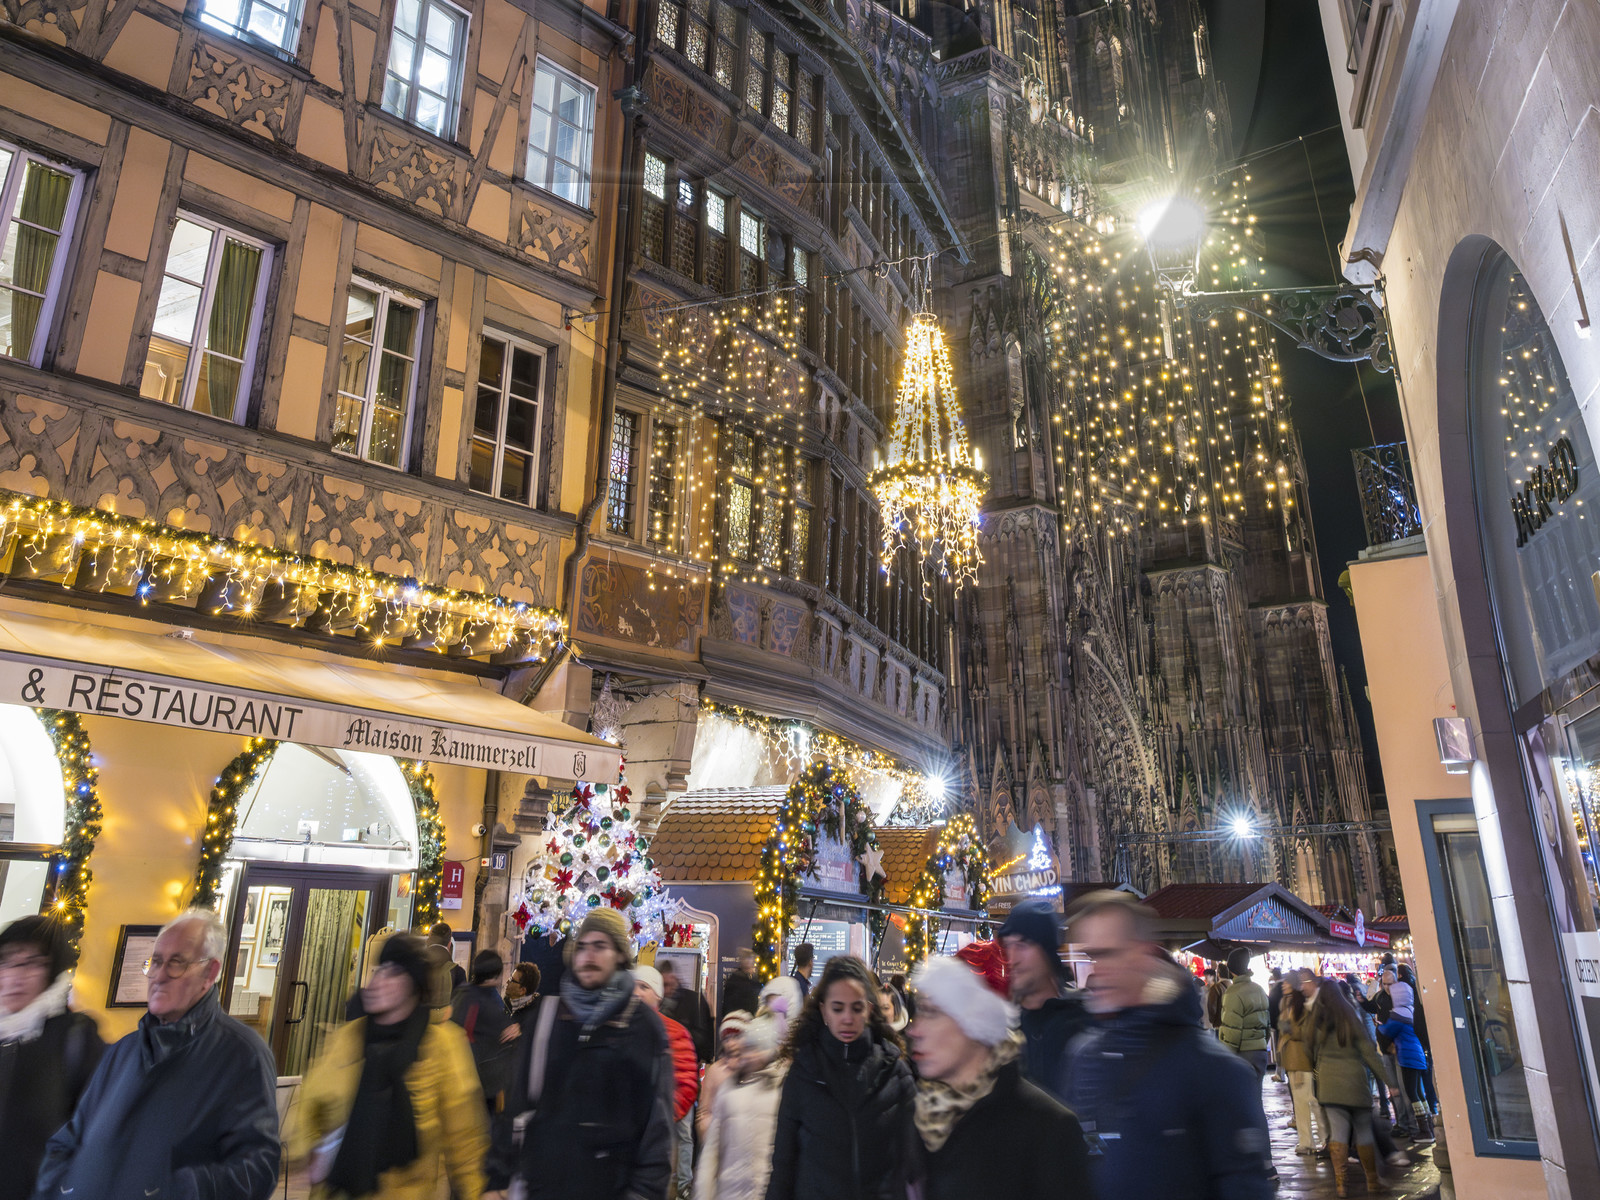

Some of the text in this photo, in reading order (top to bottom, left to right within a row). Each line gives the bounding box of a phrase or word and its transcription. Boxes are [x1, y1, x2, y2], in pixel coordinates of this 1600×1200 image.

[21, 668, 303, 738] & RESTAURANT
[343, 718, 536, 771] Maison Kammerzell
[451, 868, 462, 882] H
[989, 869, 1056, 893] VIN CHAUD
